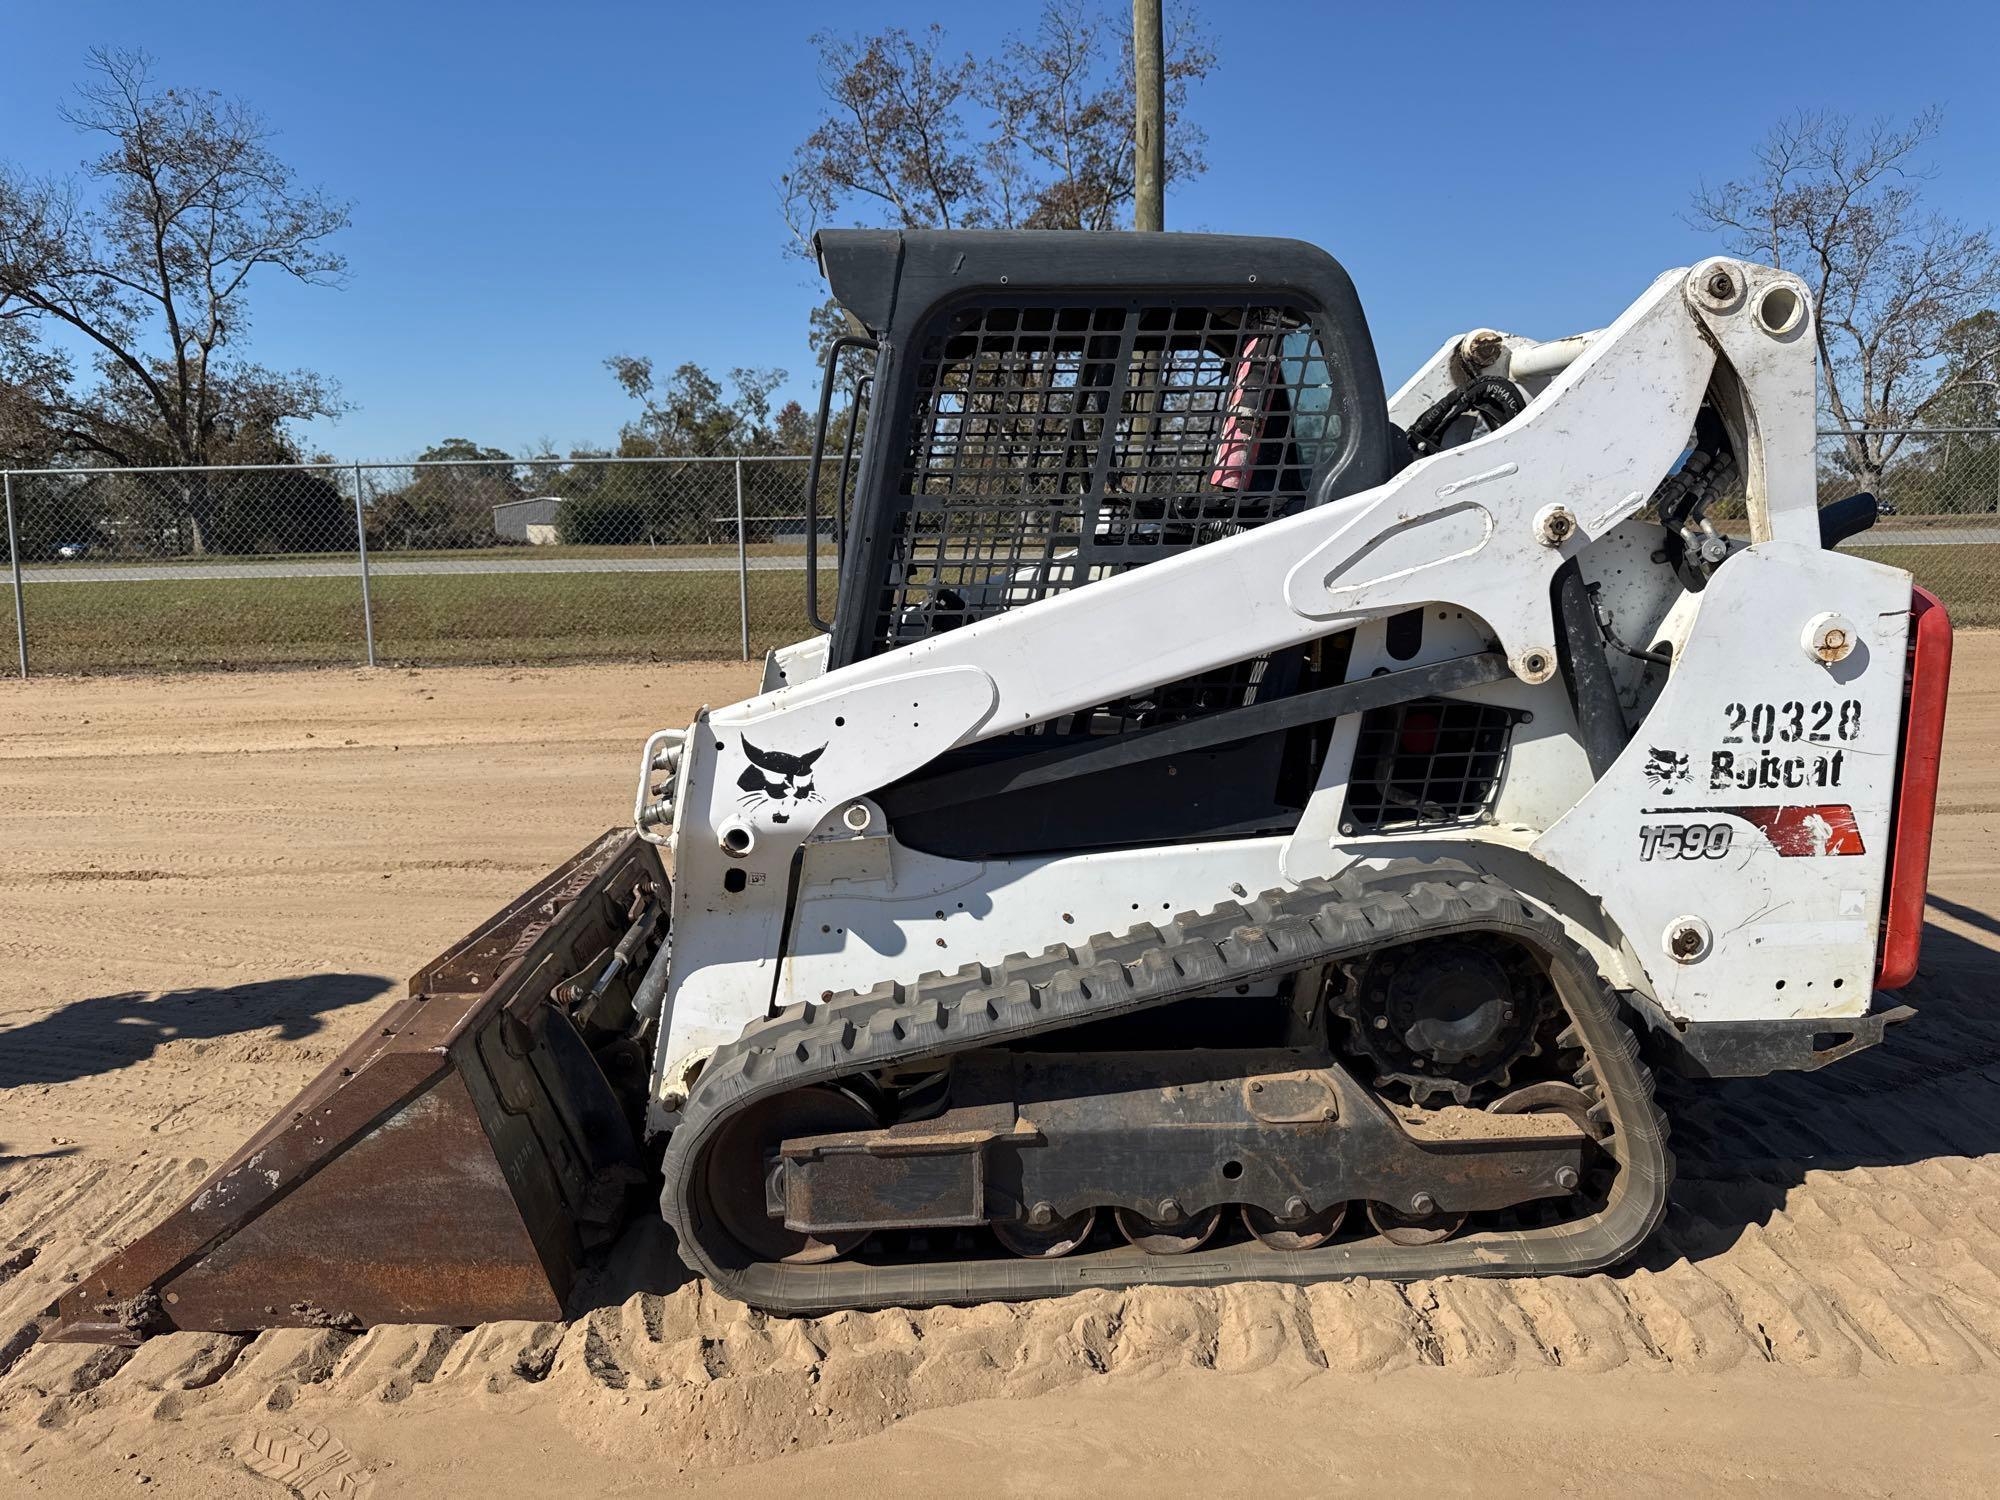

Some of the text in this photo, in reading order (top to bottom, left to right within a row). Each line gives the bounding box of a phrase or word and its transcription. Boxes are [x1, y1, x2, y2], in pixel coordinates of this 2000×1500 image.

[1486, 384, 1510, 400] MSHA
[1722, 699, 1862, 744] 20328
[1639, 823, 1733, 862] T590
